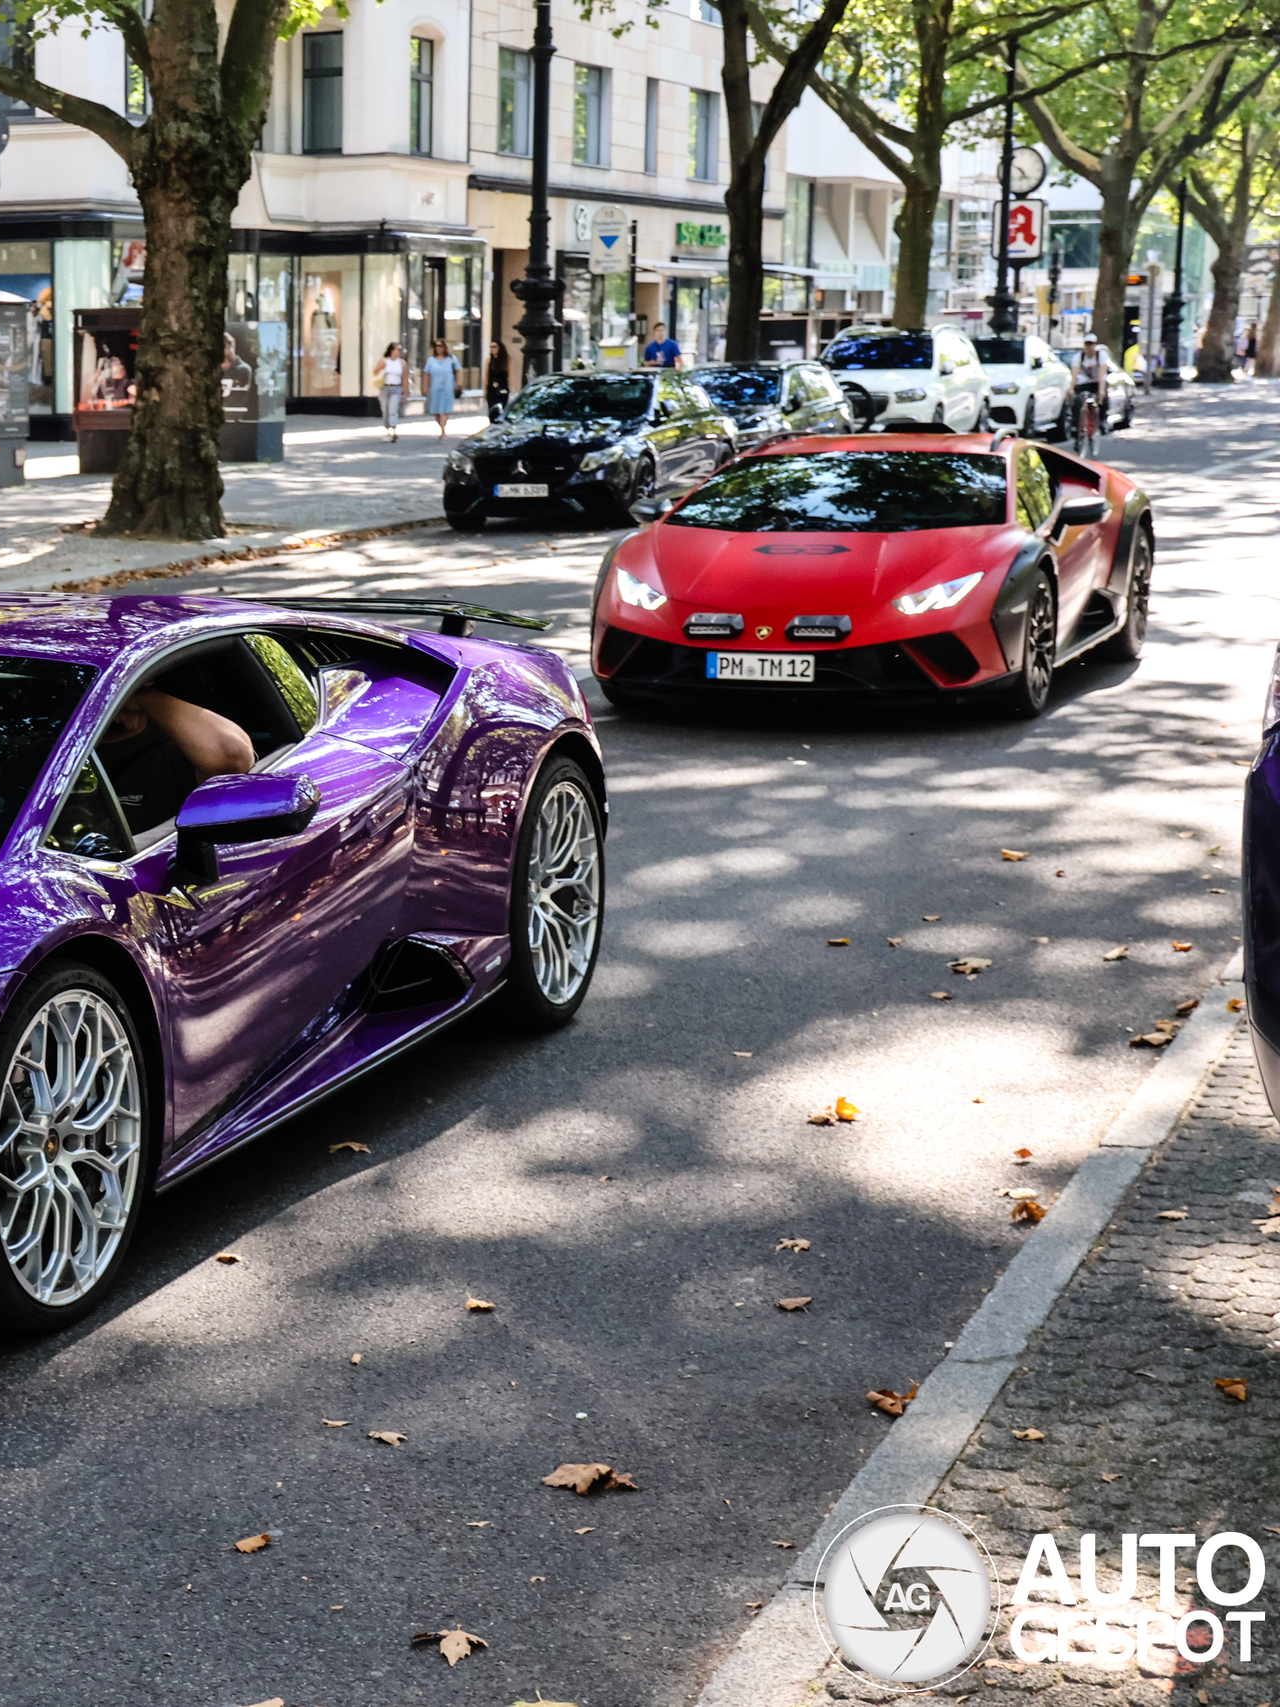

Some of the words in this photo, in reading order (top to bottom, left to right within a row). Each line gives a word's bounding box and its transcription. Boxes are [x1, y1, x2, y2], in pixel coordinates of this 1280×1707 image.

[719, 657, 744, 676] PM
[757, 658, 782, 677] TM
[787, 659, 812, 678] 12
